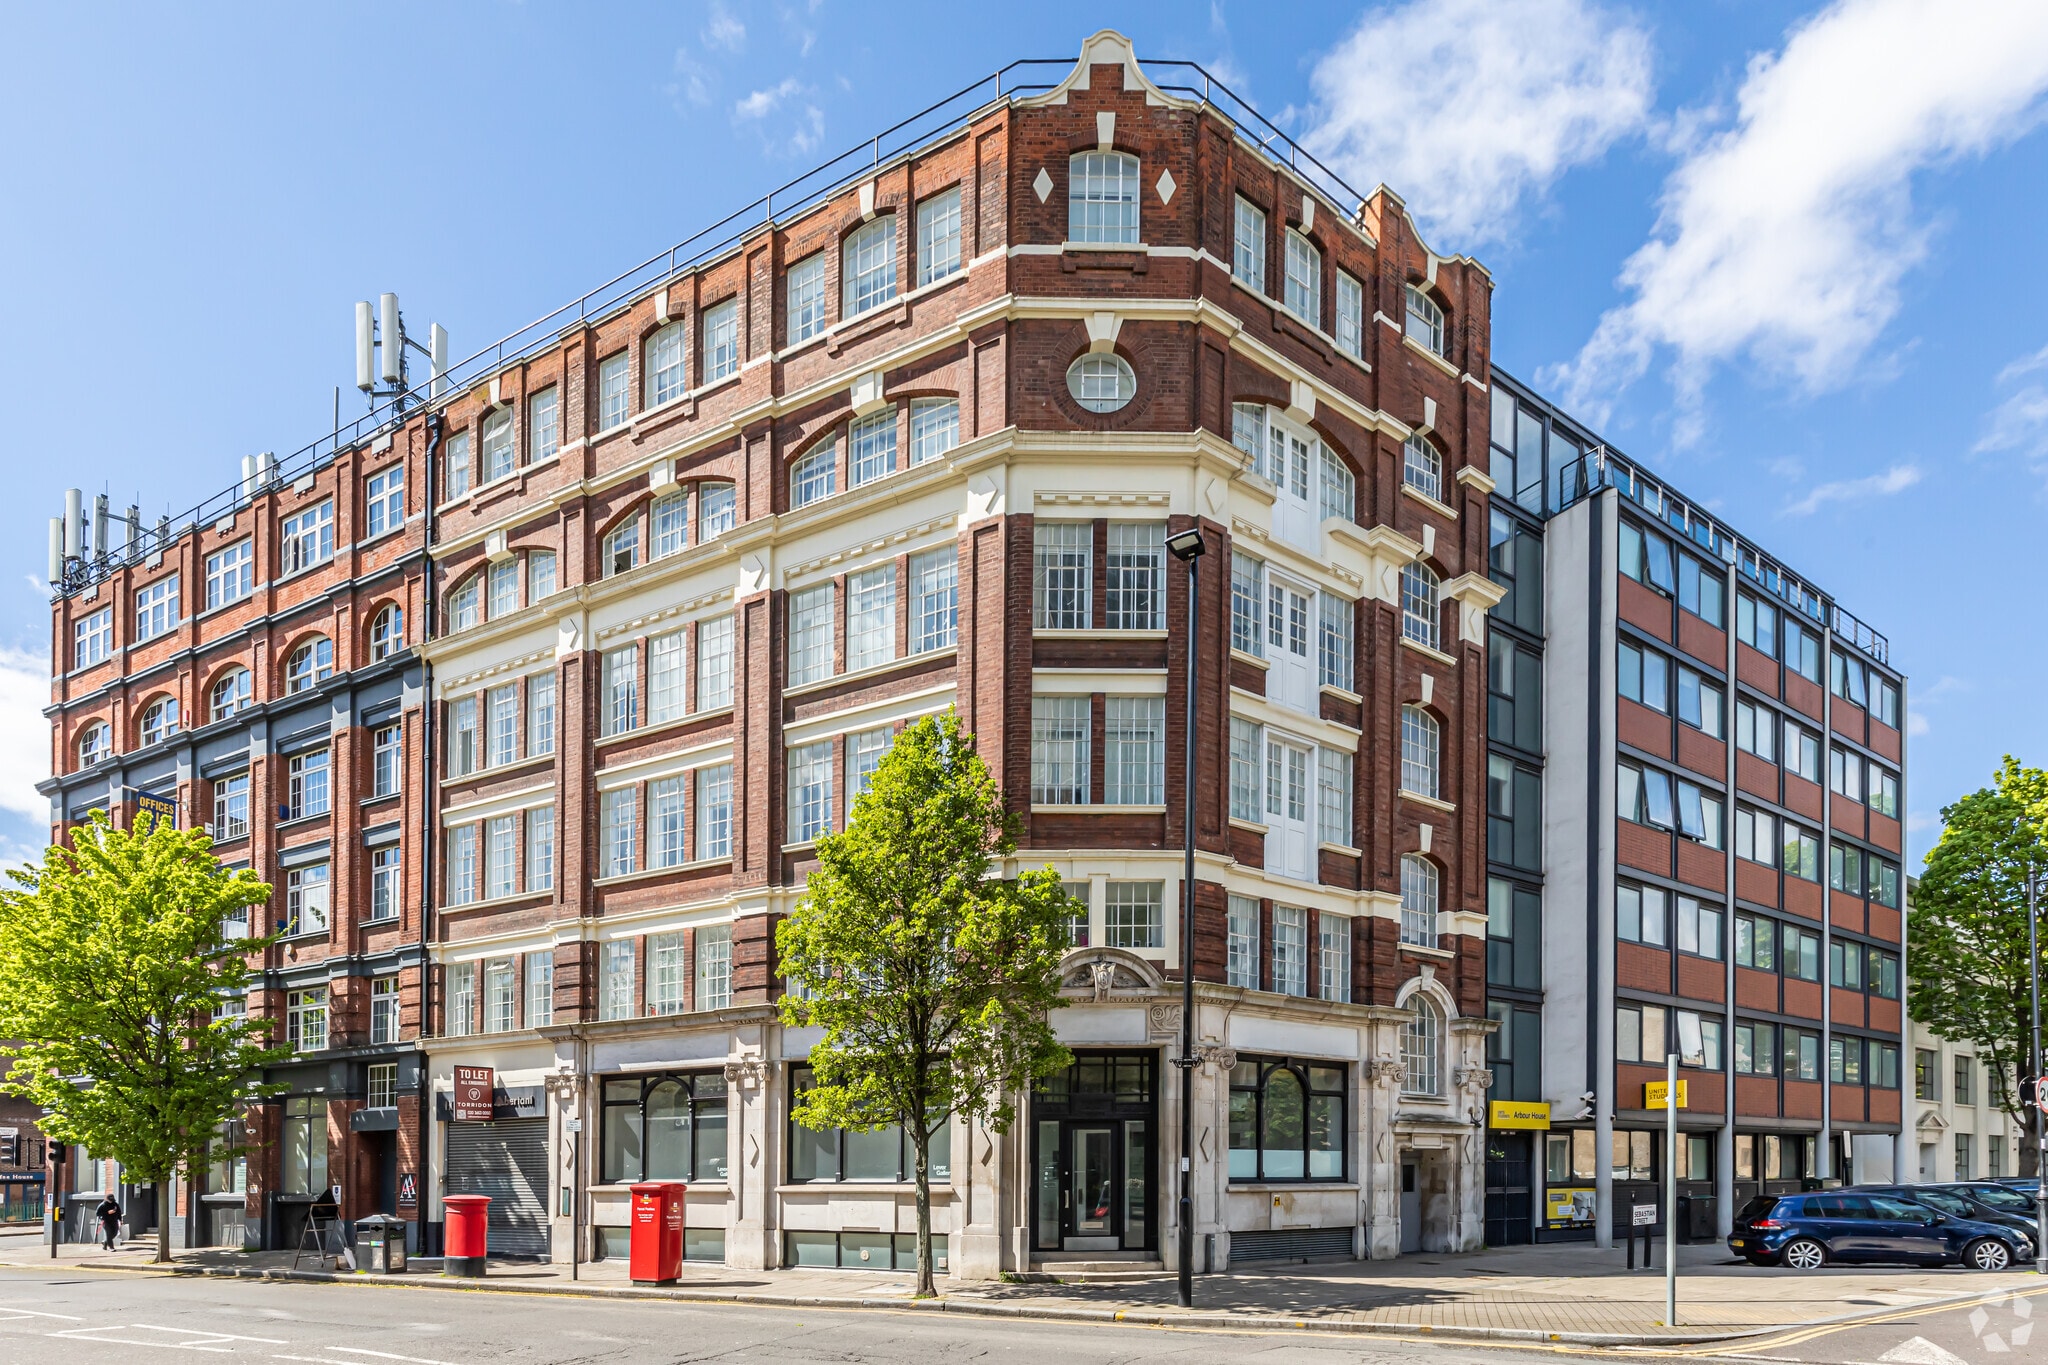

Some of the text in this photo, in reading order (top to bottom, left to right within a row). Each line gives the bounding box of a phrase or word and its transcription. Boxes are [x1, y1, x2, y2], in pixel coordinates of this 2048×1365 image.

[140, 796, 174, 814] OFFICES
[459, 1069, 488, 1080] TO LET
[2040, 1087, 2048, 1102] 2
[1532, 1112, 1547, 1120] House
